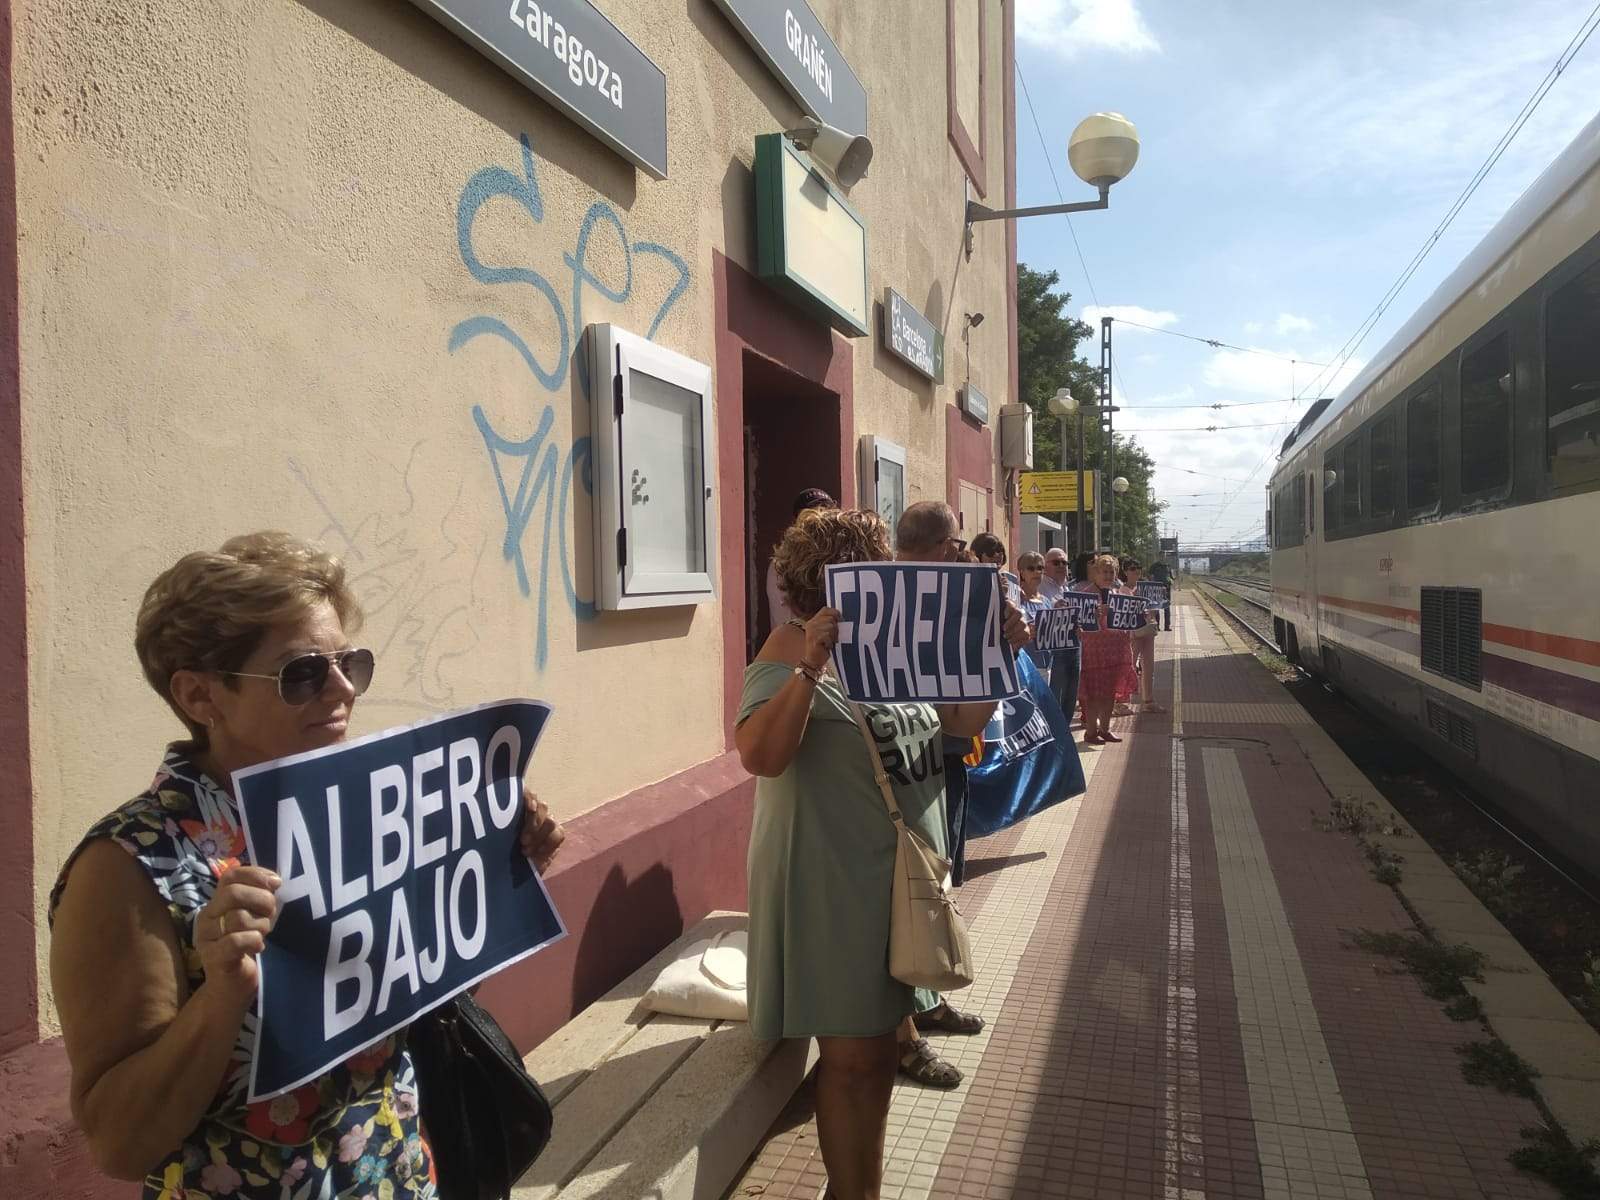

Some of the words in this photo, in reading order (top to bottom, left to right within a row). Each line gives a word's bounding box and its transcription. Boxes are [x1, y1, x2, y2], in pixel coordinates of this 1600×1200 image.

[785, 8, 833, 104] GRAÑÉN
[833, 569, 1014, 698] FRAELLA
[1036, 607, 1076, 650] CURBE
[1109, 597, 1146, 614] ALBERO
[1113, 613, 1138, 628] BAJO
[271, 725, 522, 924] ALBERO
[323, 849, 486, 1042] BAJO
